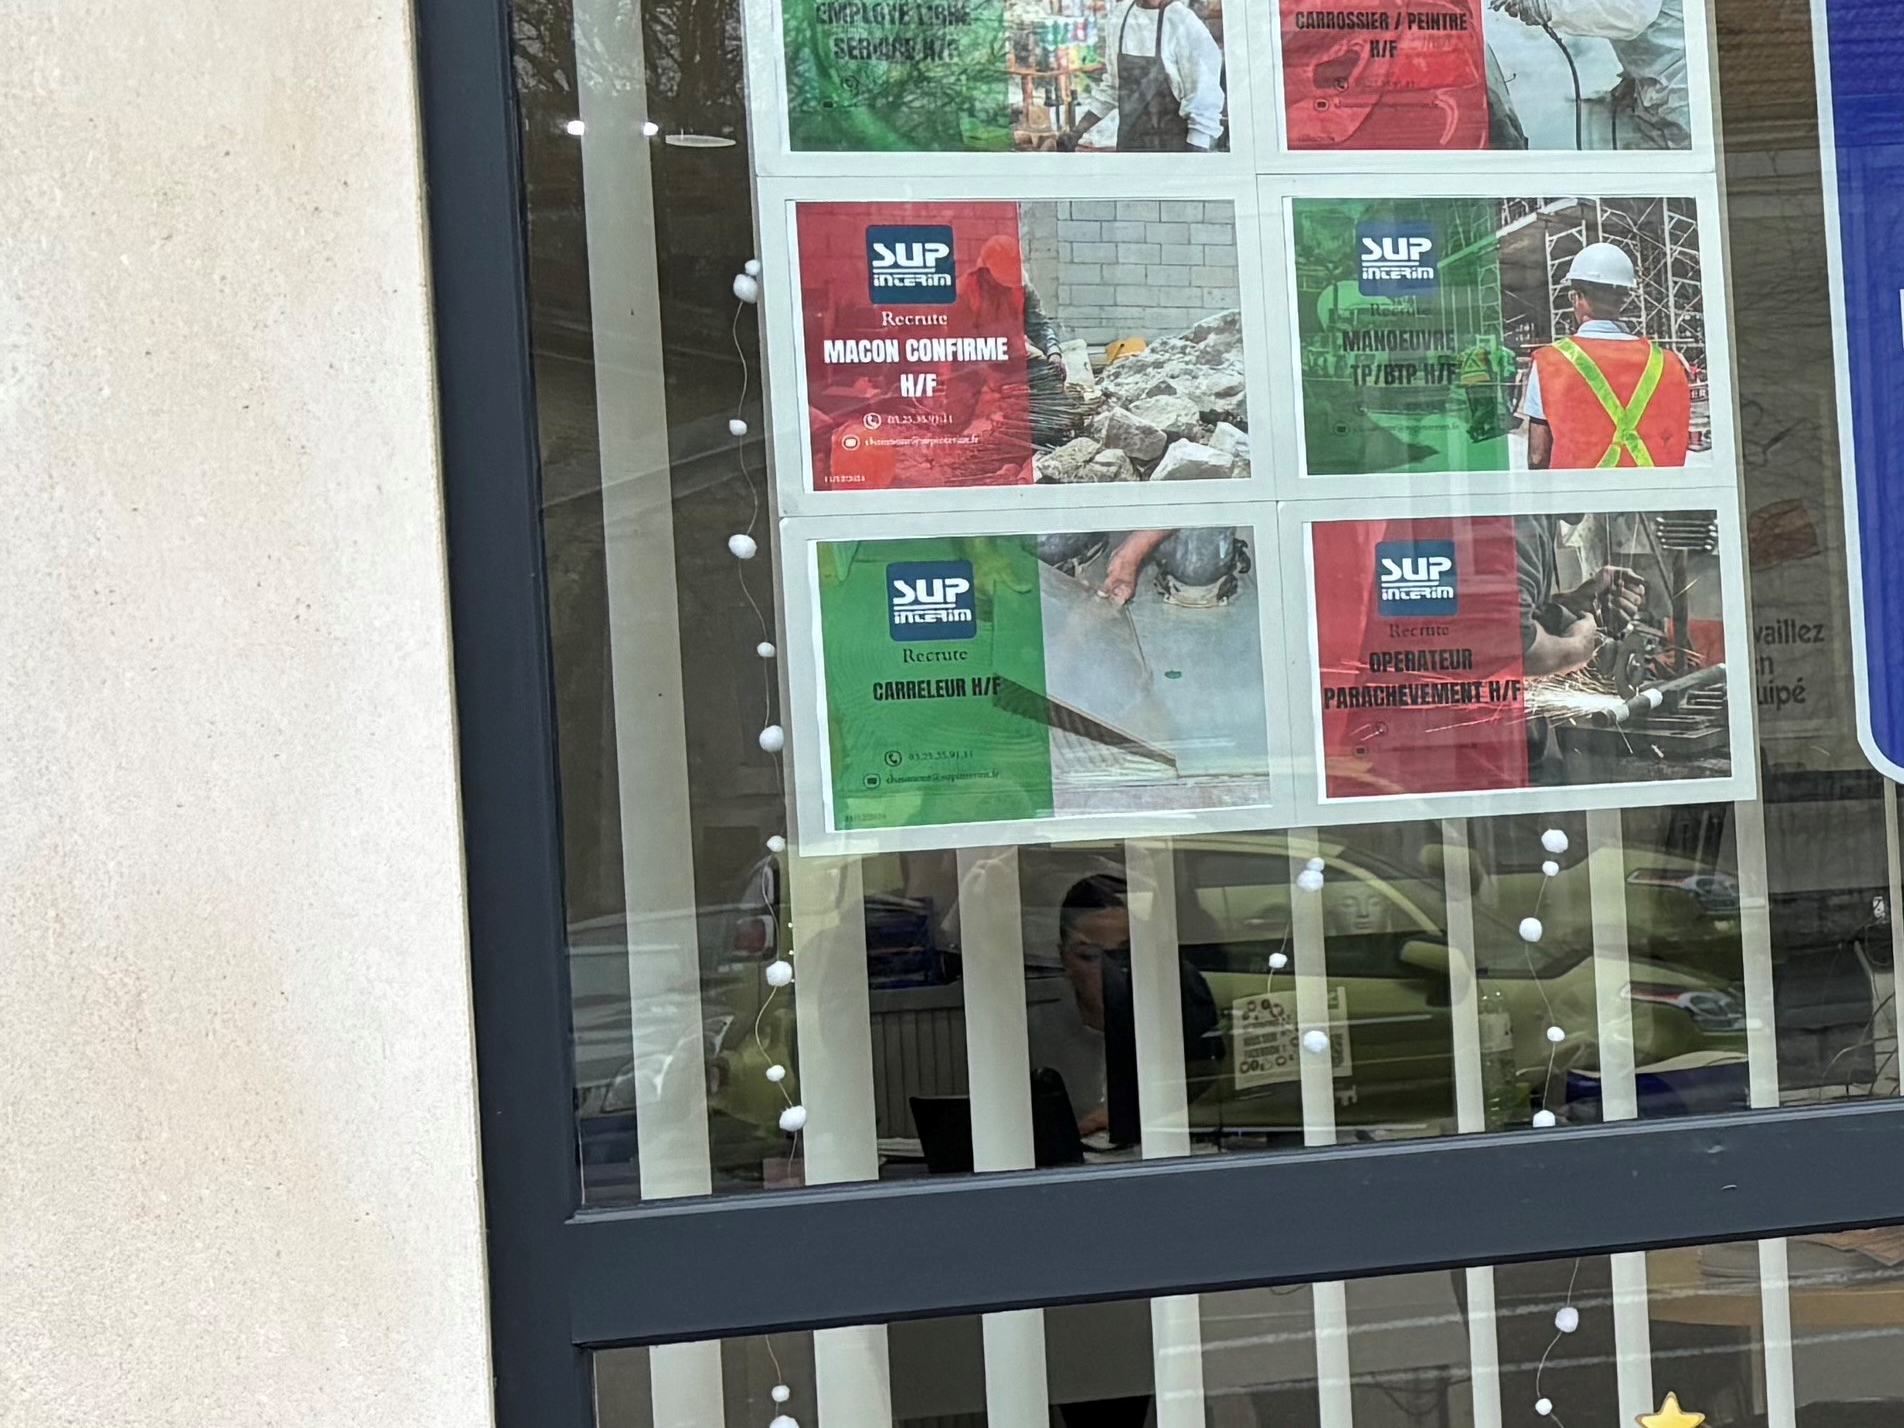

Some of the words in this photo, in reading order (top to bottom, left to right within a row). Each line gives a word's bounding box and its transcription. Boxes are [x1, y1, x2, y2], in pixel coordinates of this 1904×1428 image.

[1295, 12, 1390, 30] CARROSSIER
[1408, 13, 1468, 31] PEINTRE
[1370, 40, 1398, 58] H/F
[872, 243, 950, 268] SUP
[1361, 237, 1432, 261] SUP
[882, 311, 948, 327] Recrute
[824, 339, 899, 364] MACON
[905, 337, 1009, 361] CONFIRME
[1342, 330, 1455, 352] MANOEUVRE
[900, 373, 937, 397] H/F
[1351, 363, 1417, 386] TP/BTP
[1424, 363, 1457, 385] H/F
[1381, 556, 1452, 581] SUP
[893, 578, 970, 604] SUP
[1389, 624, 1450, 638] Recrute
[903, 649, 968, 663] Recrute
[1369, 648, 1473, 672] OPERATEUR
[873, 678, 966, 701] CARRELEUR
[972, 676, 1001, 696] H/F
[1324, 681, 1482, 709] PARACHEVEMENT
[1489, 680, 1521, 702] H/F
